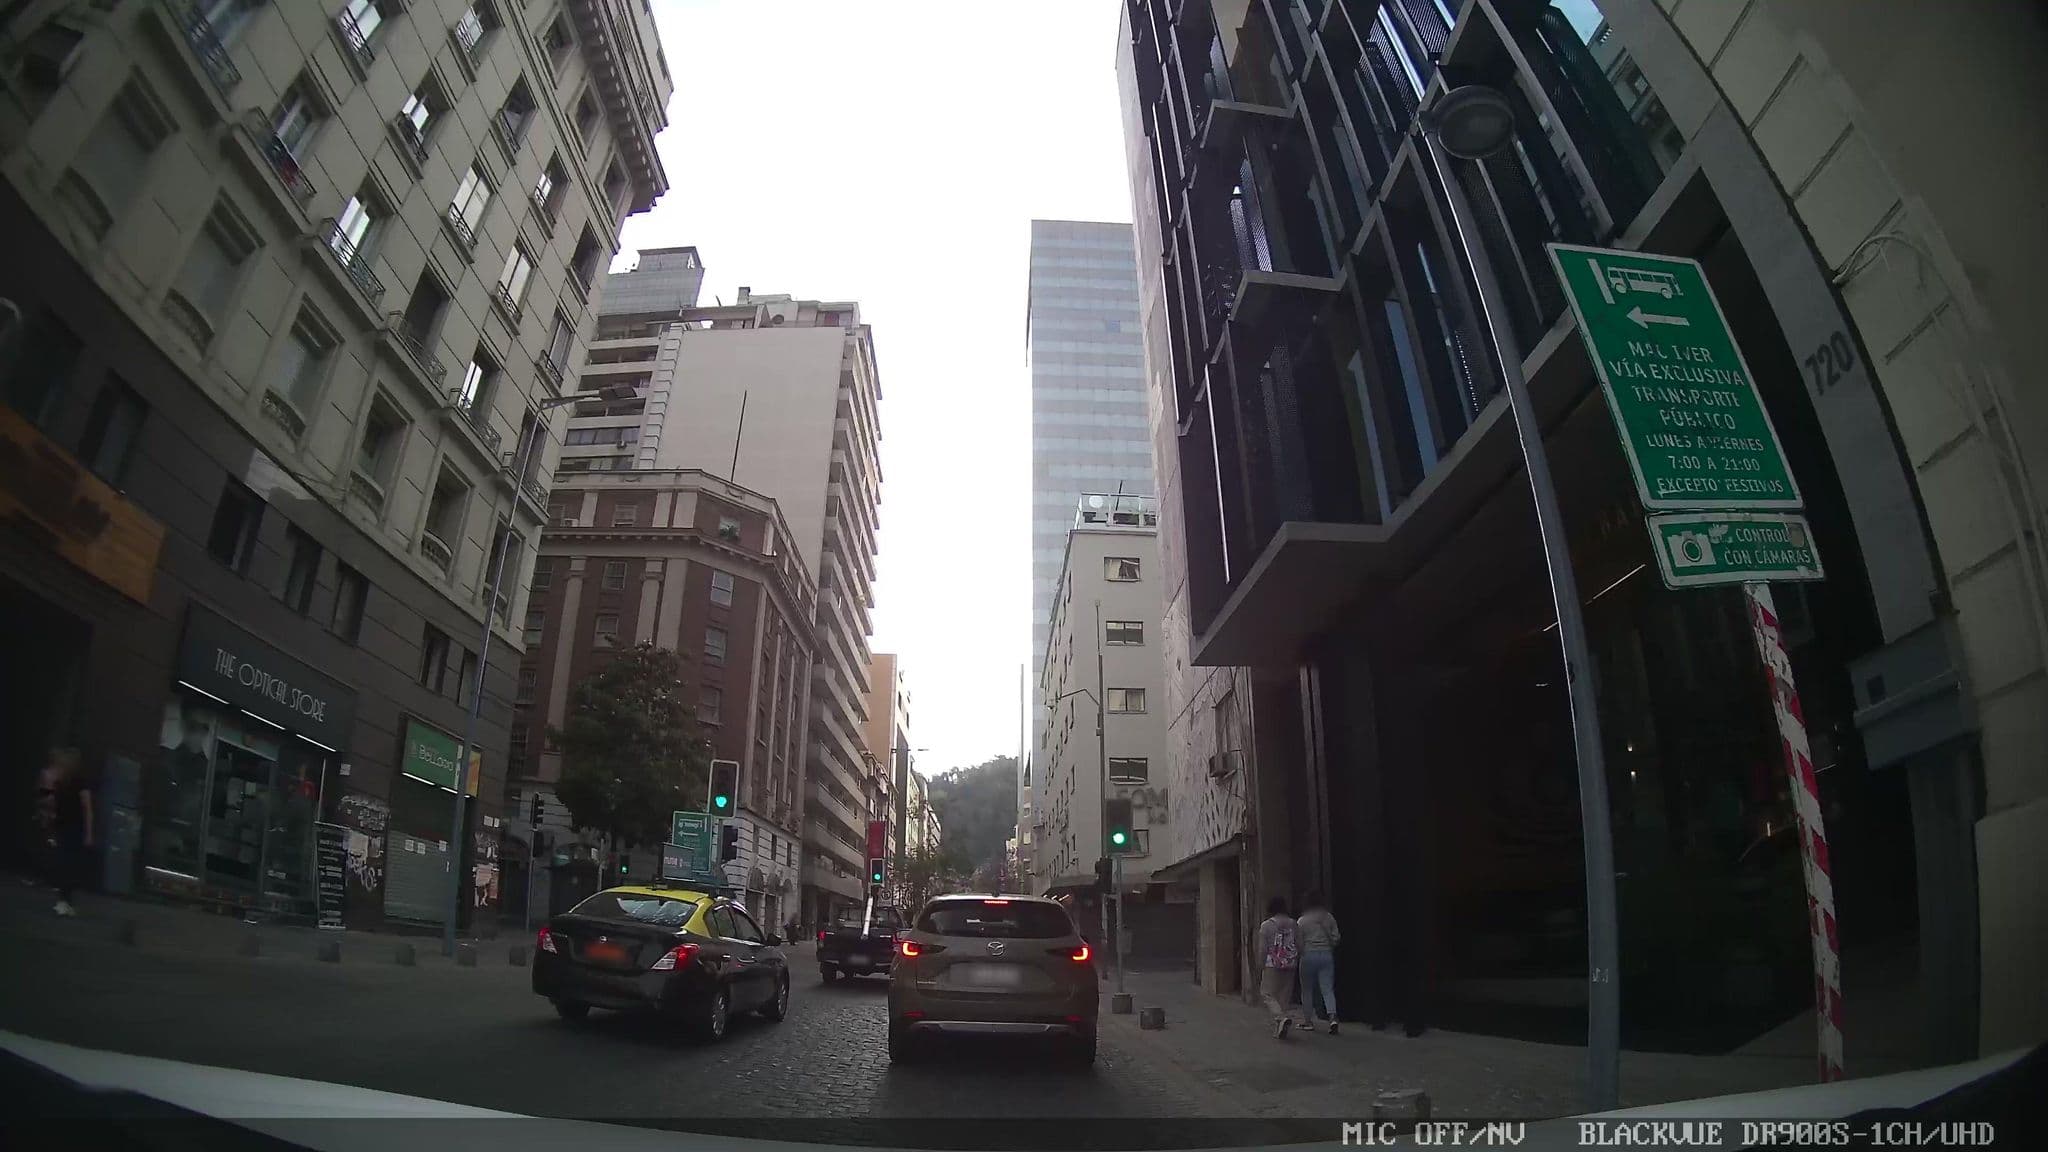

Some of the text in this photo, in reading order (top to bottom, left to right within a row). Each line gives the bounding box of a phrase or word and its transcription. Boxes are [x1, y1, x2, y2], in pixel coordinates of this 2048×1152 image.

[1628, 340, 1713, 363] MAC IVER
[1804, 330, 1855, 396] 720
[1609, 357, 1745, 386] VÍA EXCLUSIVA
[1632, 385, 1740, 408] TRANSPORTE
[1659, 407, 1736, 430] PÚBLICO
[1645, 434, 1692, 449] LUNES
[1697, 435, 1708, 449] A
[1667, 455, 1761, 472] 7:00 A 21:00
[1656, 477, 1785, 493] EXCEPTO FESTIVOS
[1735, 527, 1789, 543] CONTROL
[1723, 545, 1812, 566] CON CÁMARAS
[215, 648, 327, 722] THE OPTICAL STORE
